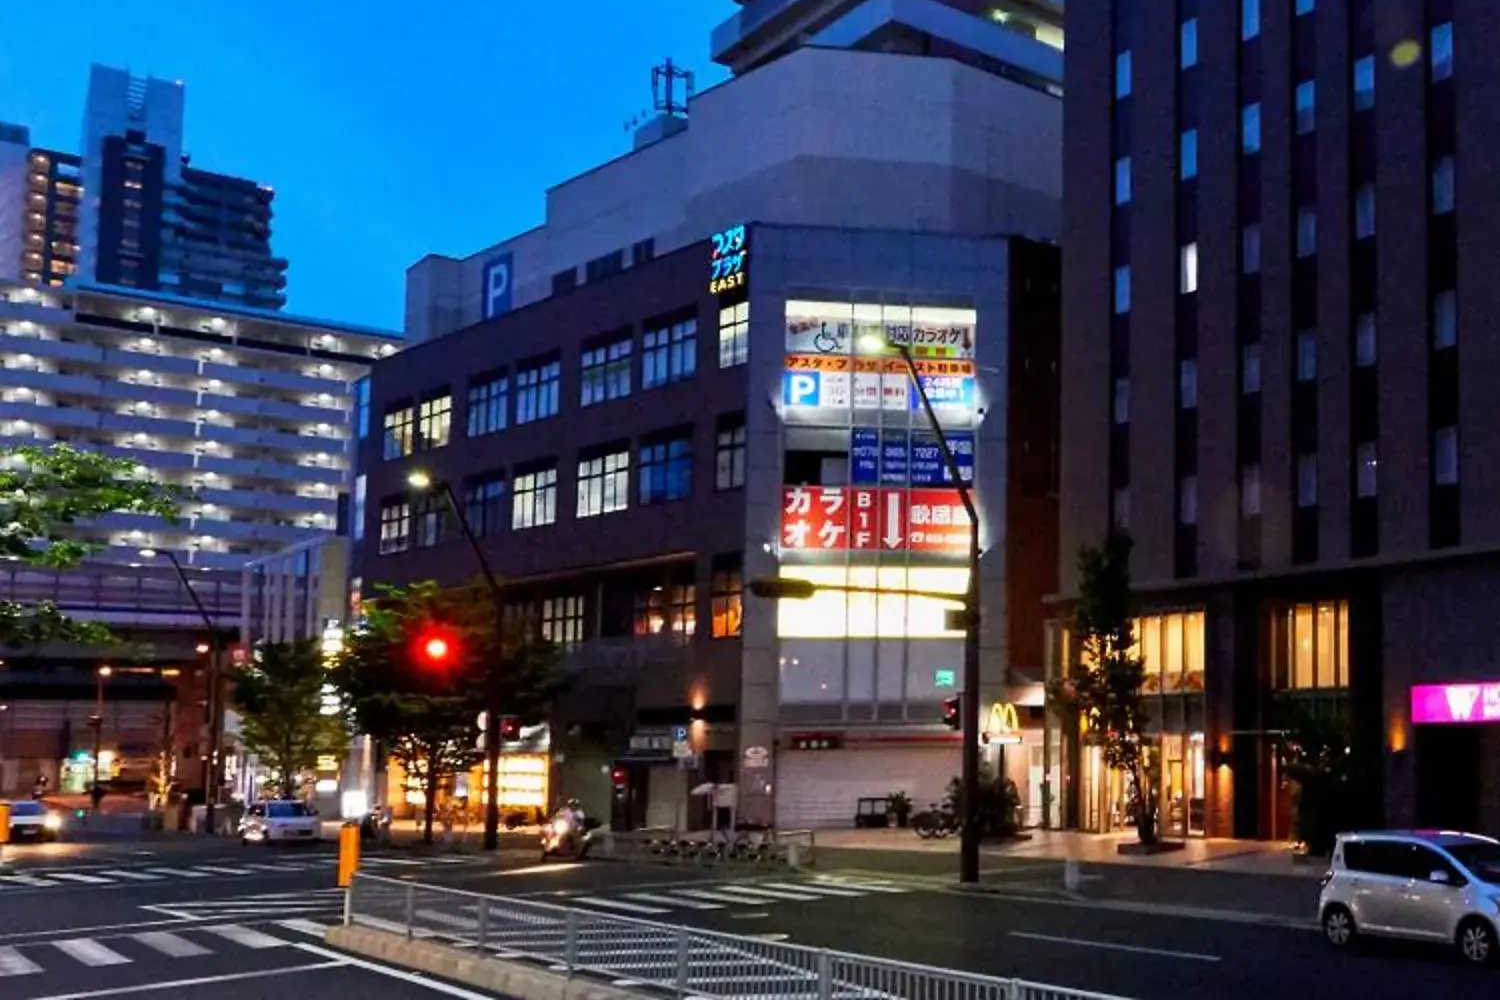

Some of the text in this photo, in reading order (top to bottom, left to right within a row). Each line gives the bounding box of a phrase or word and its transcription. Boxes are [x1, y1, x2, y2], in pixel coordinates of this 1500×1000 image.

[486, 263, 508, 319] P
[709, 271, 746, 295] EAST
[790, 375, 816, 403] P
